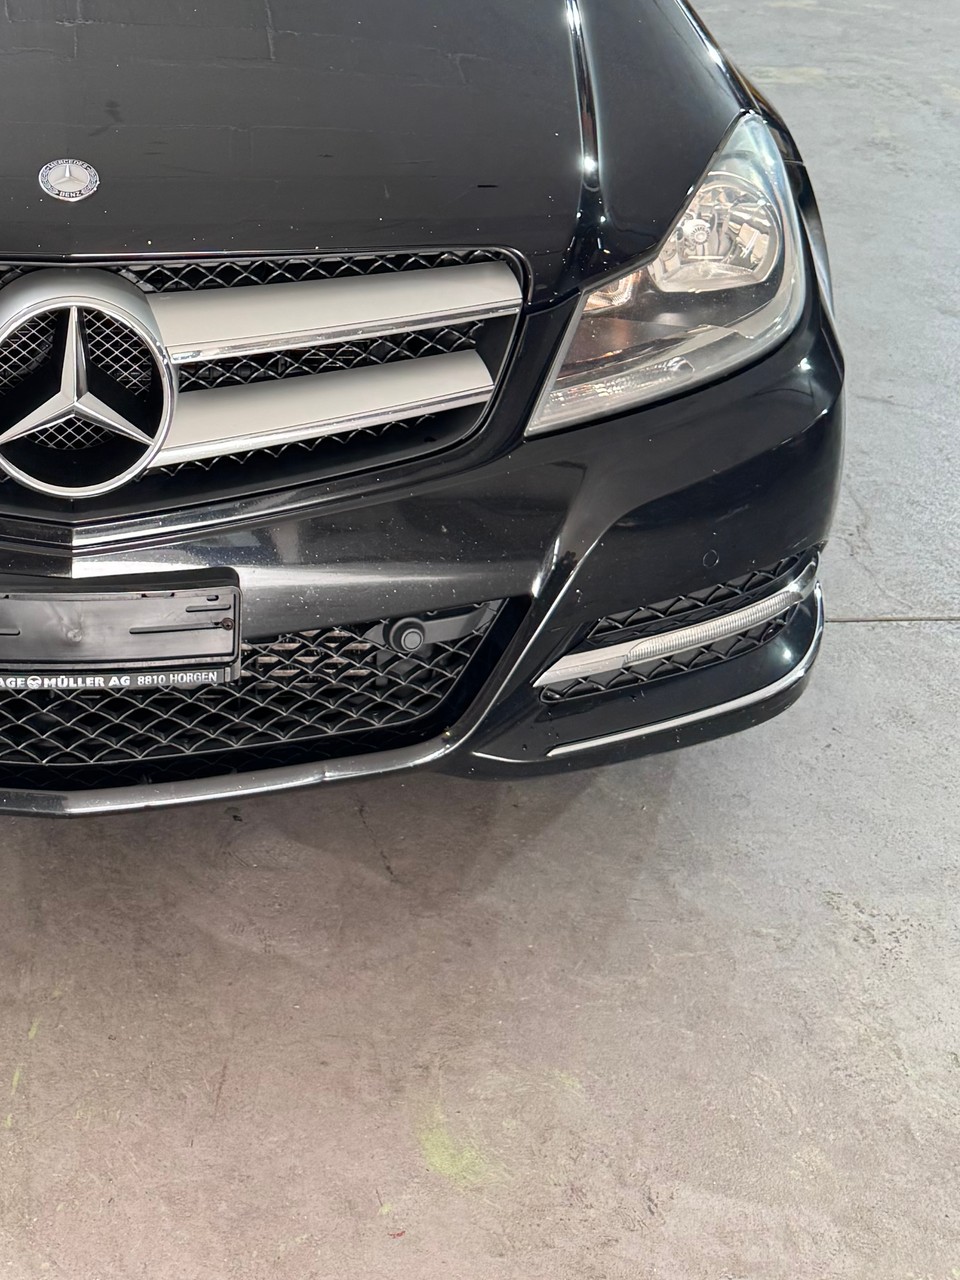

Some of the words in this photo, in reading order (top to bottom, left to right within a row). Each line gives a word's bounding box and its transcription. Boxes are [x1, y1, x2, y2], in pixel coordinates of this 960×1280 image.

[43, 675, 105, 688] MÜLLER
[108, 675, 131, 687] AG
[137, 674, 166, 686] 8810
[169, 671, 218, 685] HORGEN
